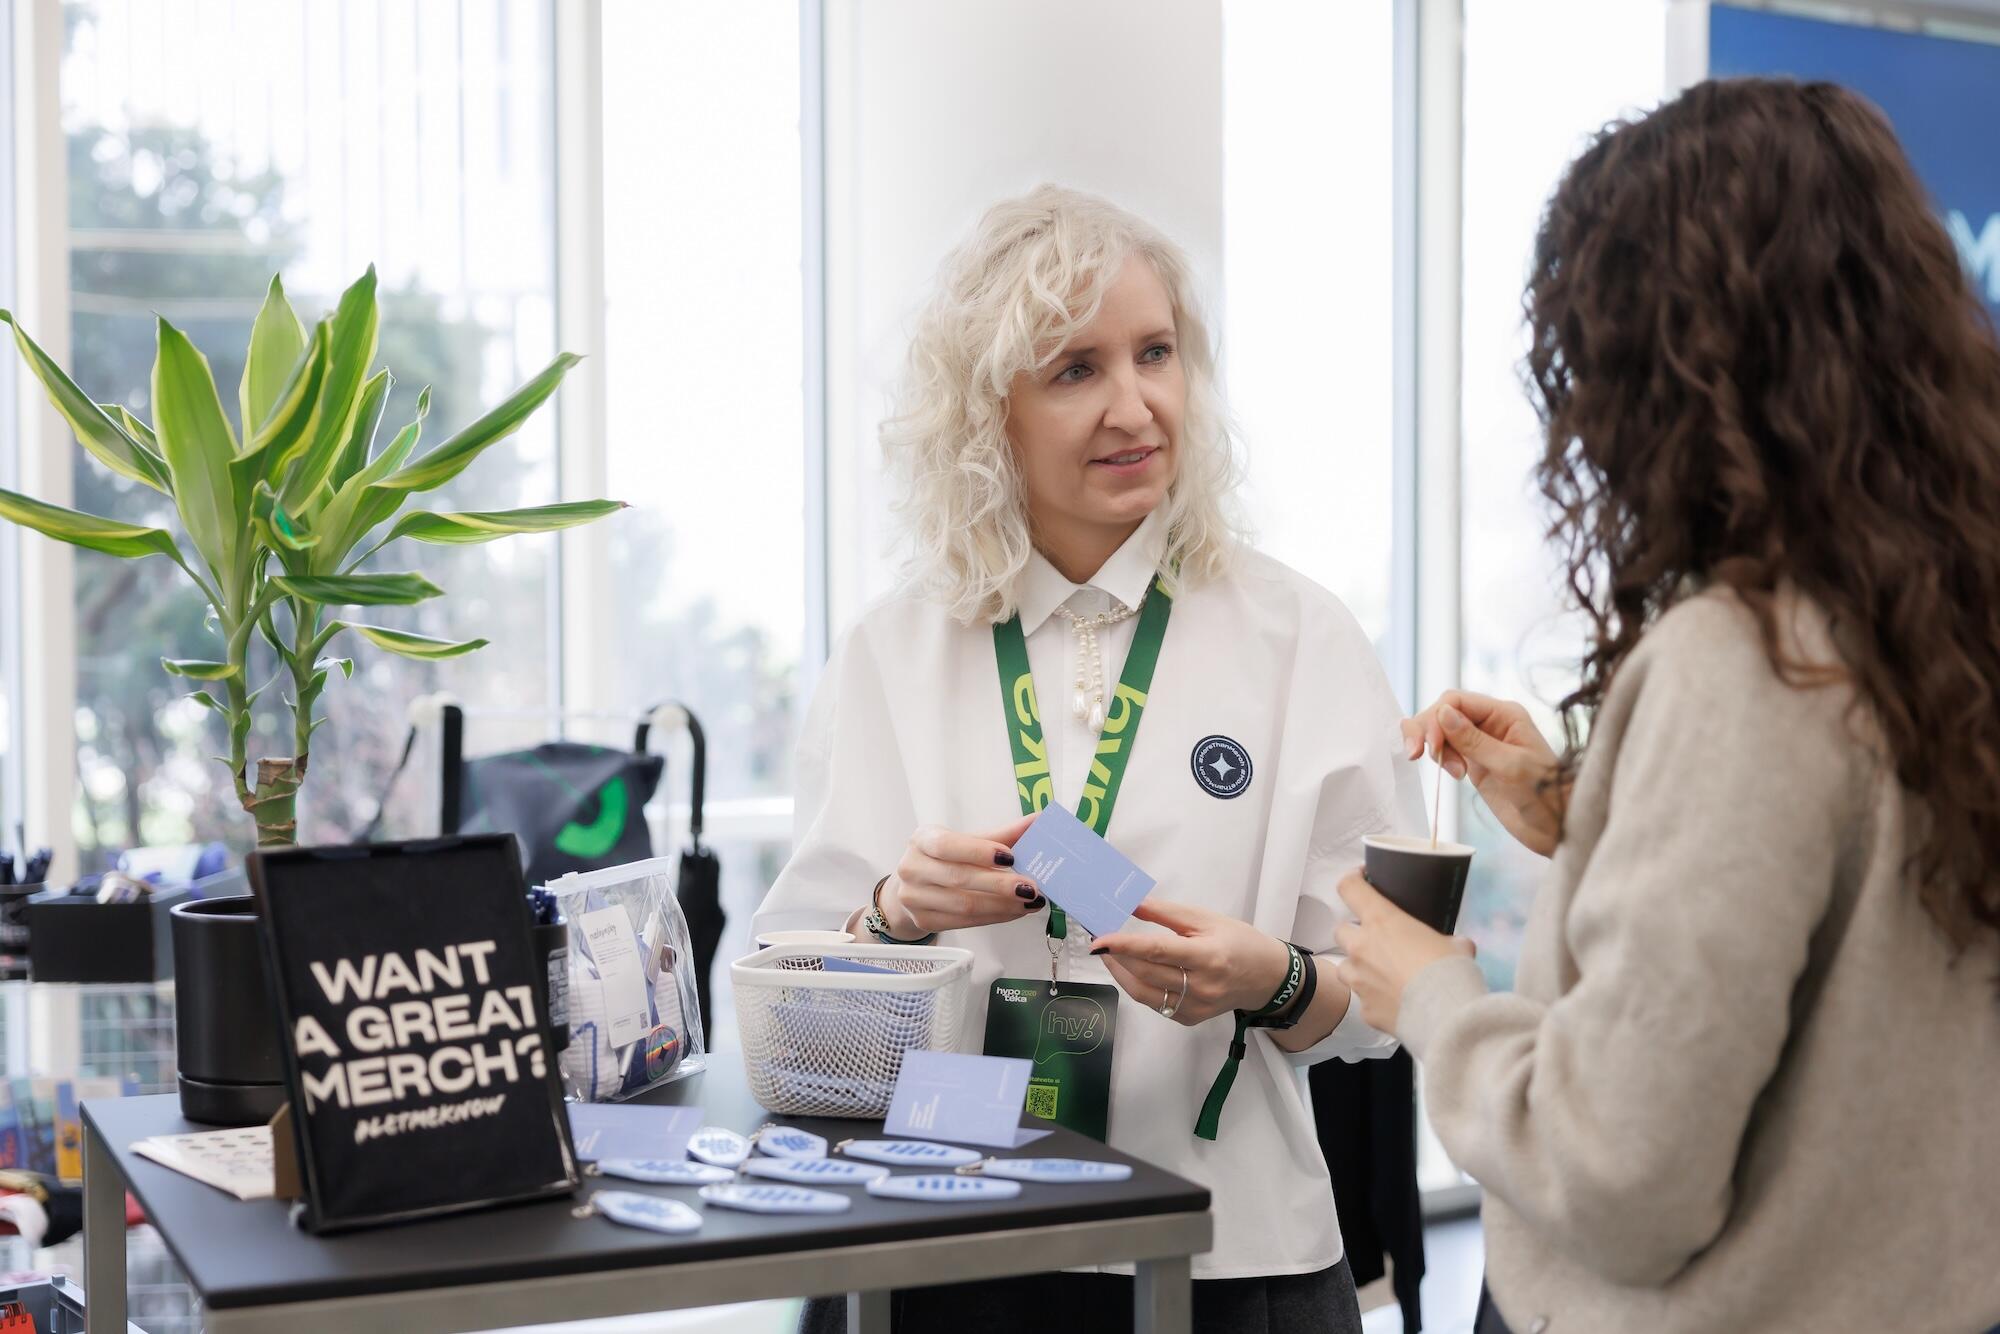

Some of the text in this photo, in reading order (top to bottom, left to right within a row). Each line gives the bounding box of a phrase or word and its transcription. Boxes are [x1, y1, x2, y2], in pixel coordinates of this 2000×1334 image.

[309, 939, 498, 1005] WANT
[996, 986, 1021, 997] hypo
[294, 1014, 342, 1059] A
[346, 985, 538, 1053] GREAT
[1047, 1011, 1100, 1040] hy!
[301, 1033, 547, 1116] MERCH?
